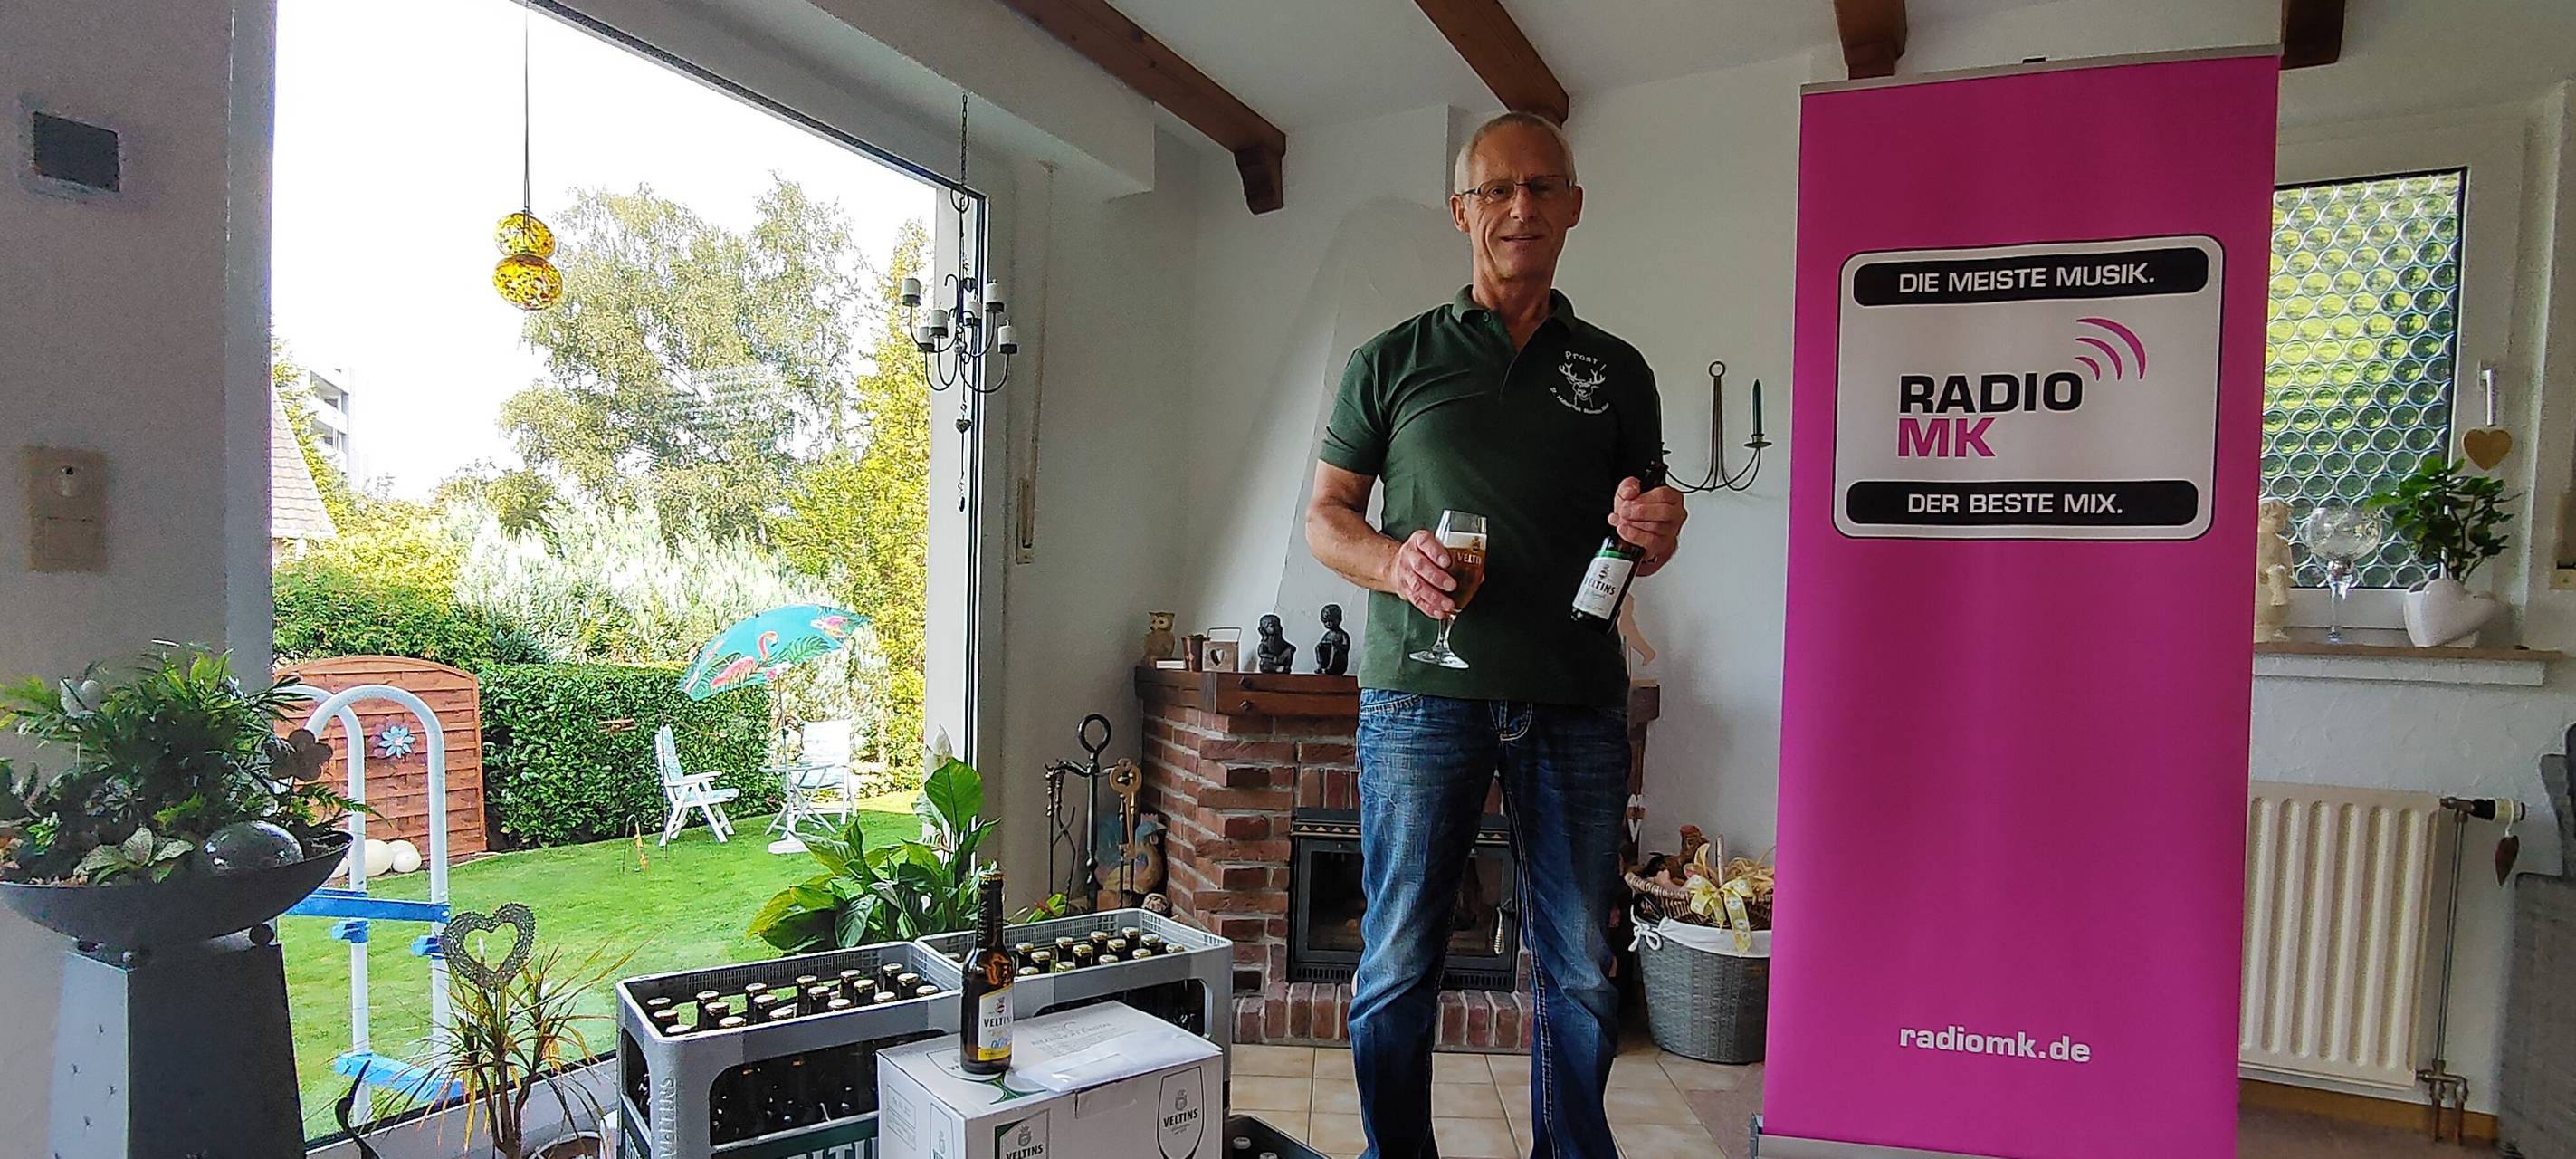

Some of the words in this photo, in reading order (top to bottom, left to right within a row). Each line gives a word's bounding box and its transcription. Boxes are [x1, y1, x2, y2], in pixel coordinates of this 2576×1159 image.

[1899, 273, 1939, 293] DIE
[1948, 268, 2046, 292] MEISTE
[2056, 263, 2155, 287] MUSIK.
[1899, 372, 2084, 413] RADIO
[1897, 417, 1996, 458] MK
[1907, 494, 1959, 514] DER
[1969, 493, 2054, 514] BESTE
[2063, 493, 2123, 514] MIX.
[1899, 1025, 2091, 1063] radiomk.de
[1163, 1107, 1198, 1128] VELTINS
